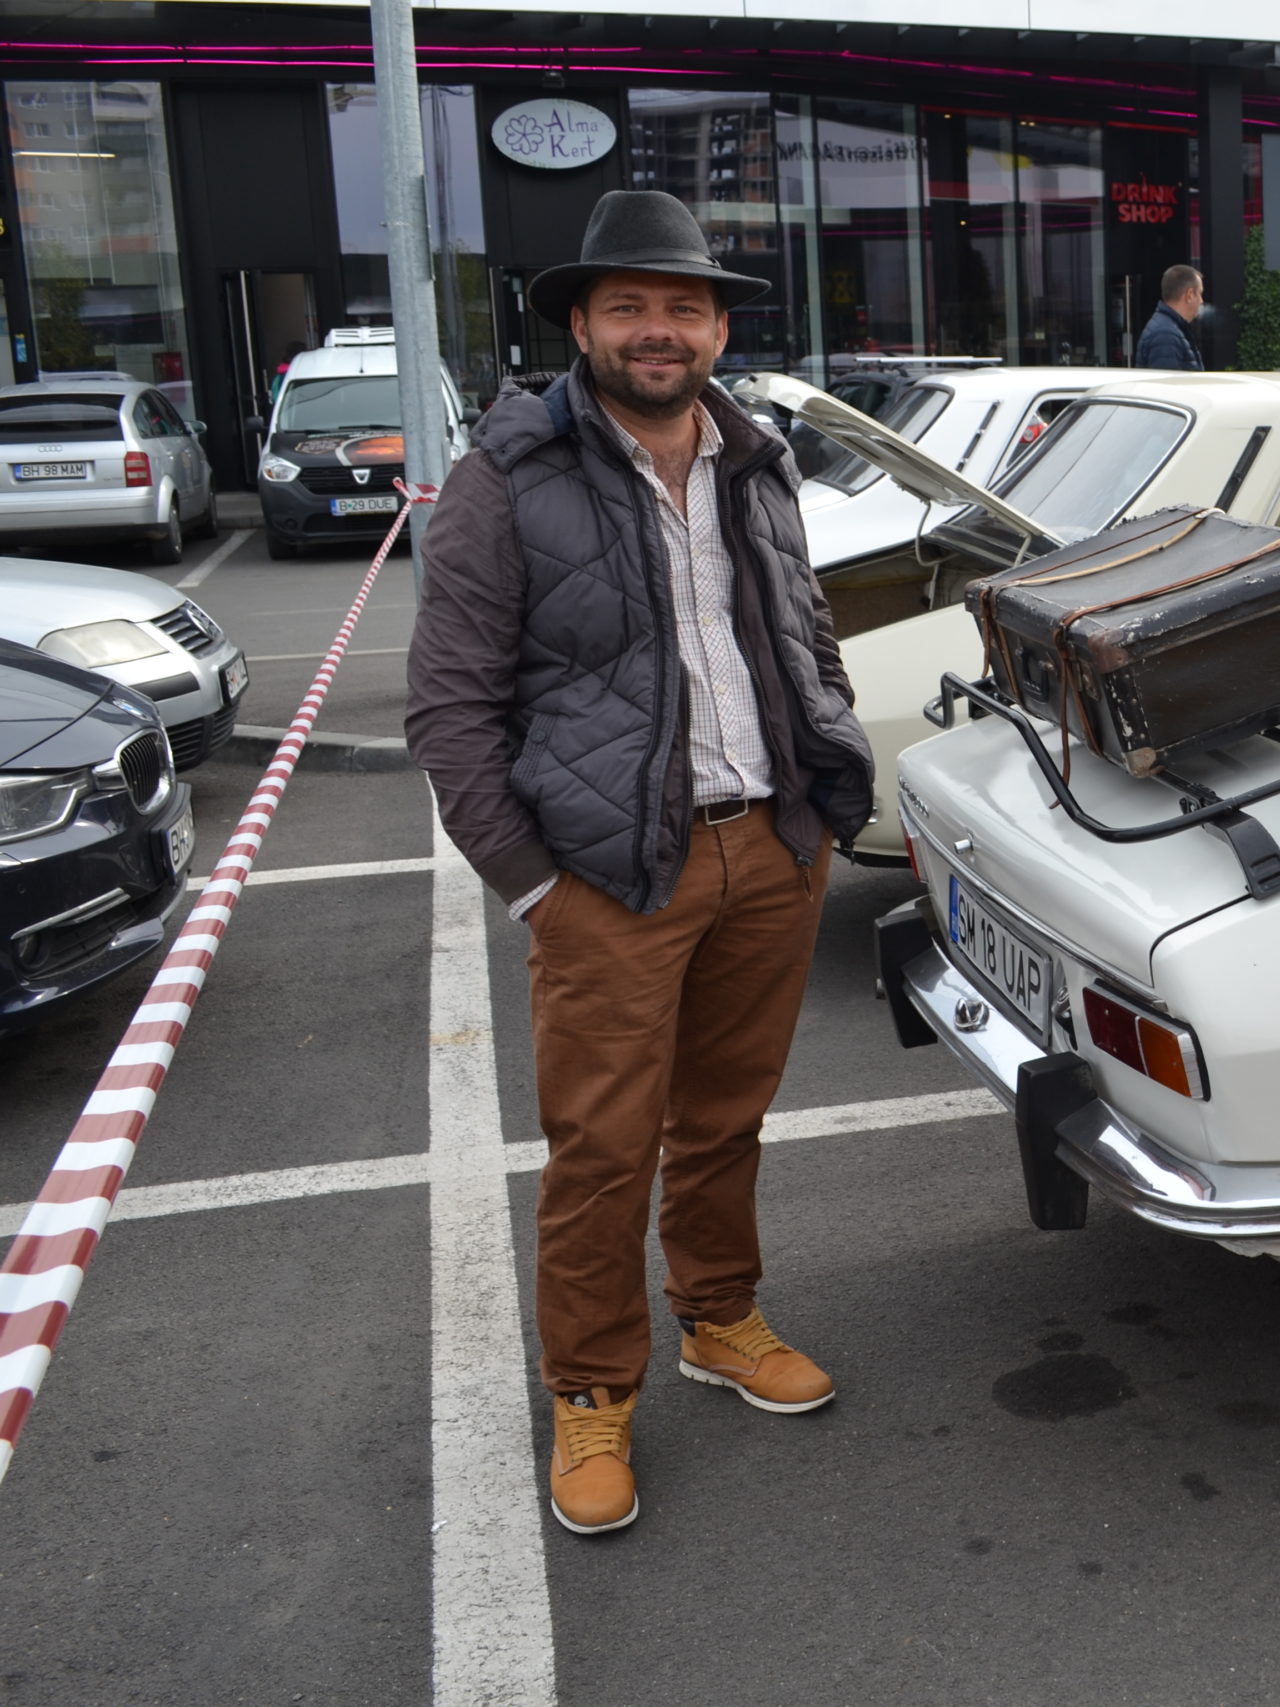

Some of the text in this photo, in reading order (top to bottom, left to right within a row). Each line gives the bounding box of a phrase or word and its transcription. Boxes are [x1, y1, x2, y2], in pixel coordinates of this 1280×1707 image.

[544, 108, 598, 133] Alma
[551, 134, 595, 158] Kert
[1111, 176, 1178, 204] DRINK
[1118, 204, 1174, 224] SHOP
[22, 465, 40, 477] BH
[339, 498, 393, 512] B 29 DUE
[958, 893, 1042, 1012] SM 18 UAP
